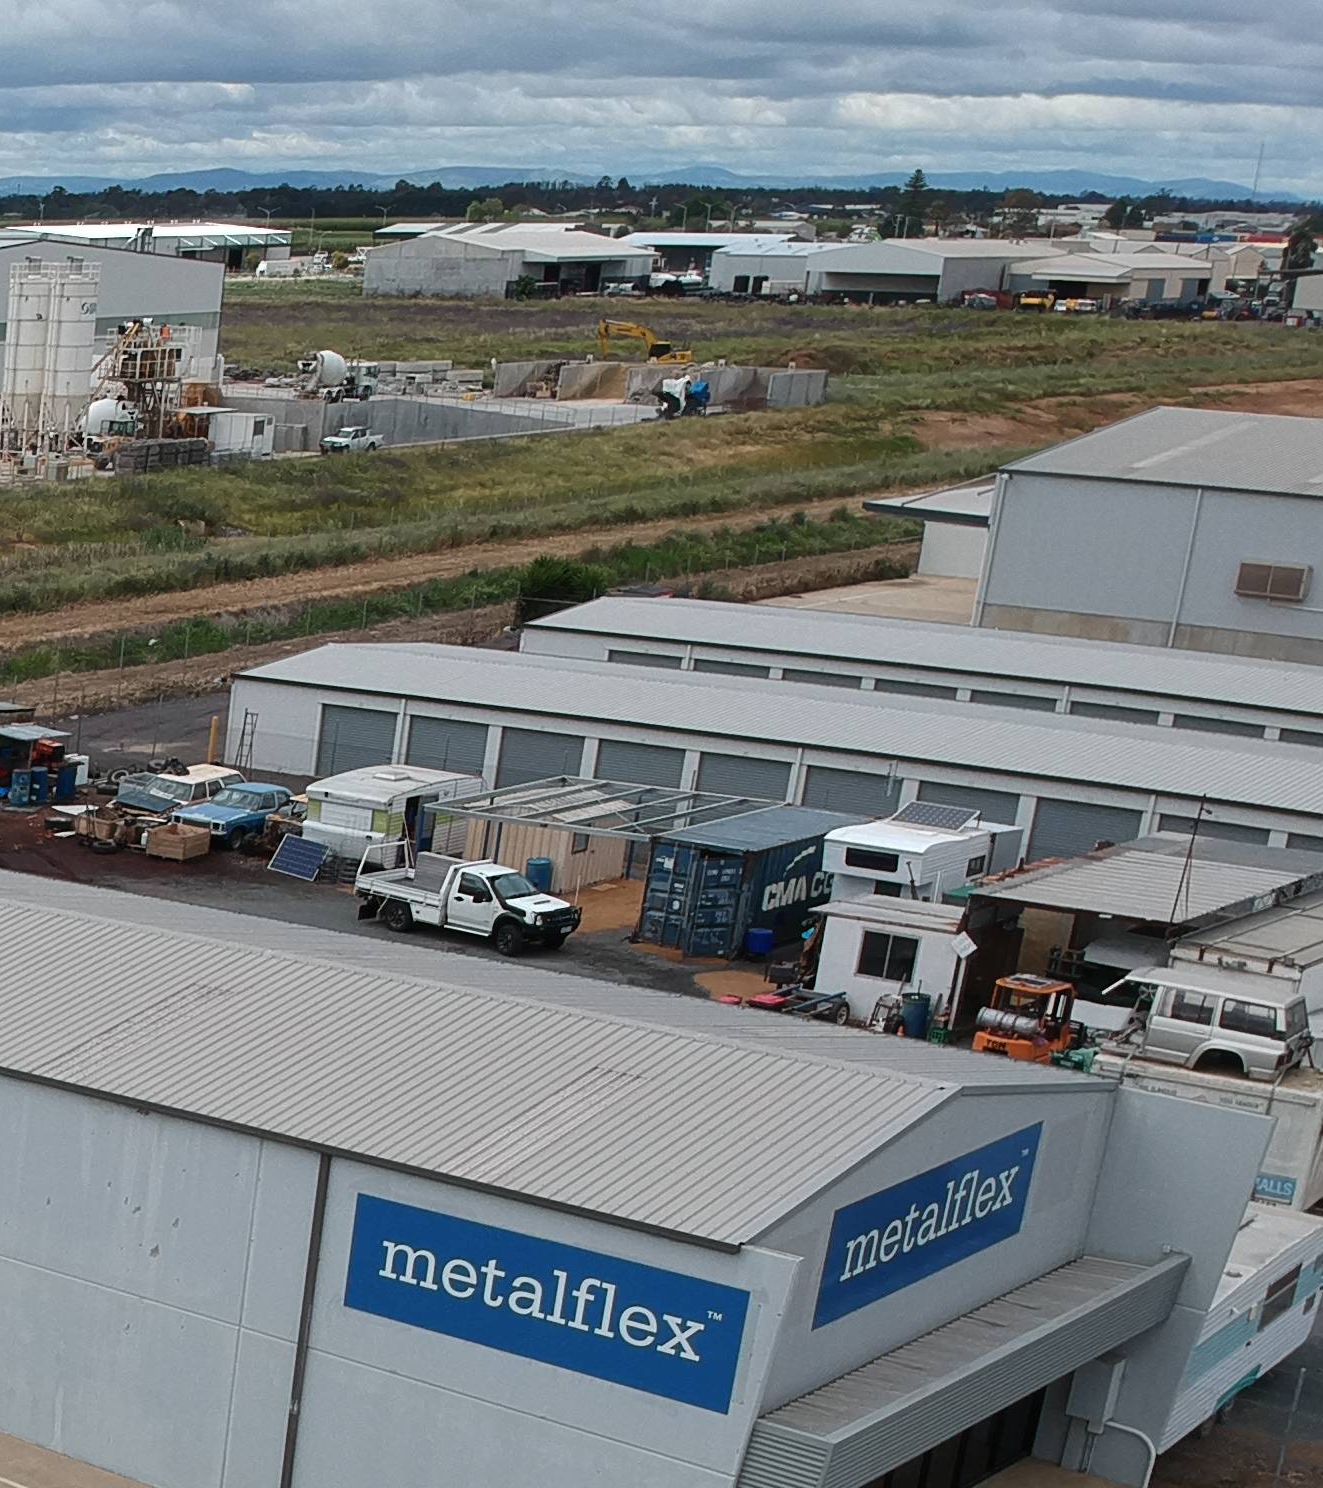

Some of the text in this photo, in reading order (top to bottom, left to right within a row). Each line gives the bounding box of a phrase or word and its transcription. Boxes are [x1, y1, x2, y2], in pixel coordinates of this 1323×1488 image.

[761, 875, 807, 912] CMA
[839, 1165, 1020, 1282] metalflex
[1255, 1178, 1293, 1195] ALLS
[378, 1240, 706, 1362] metalflex
